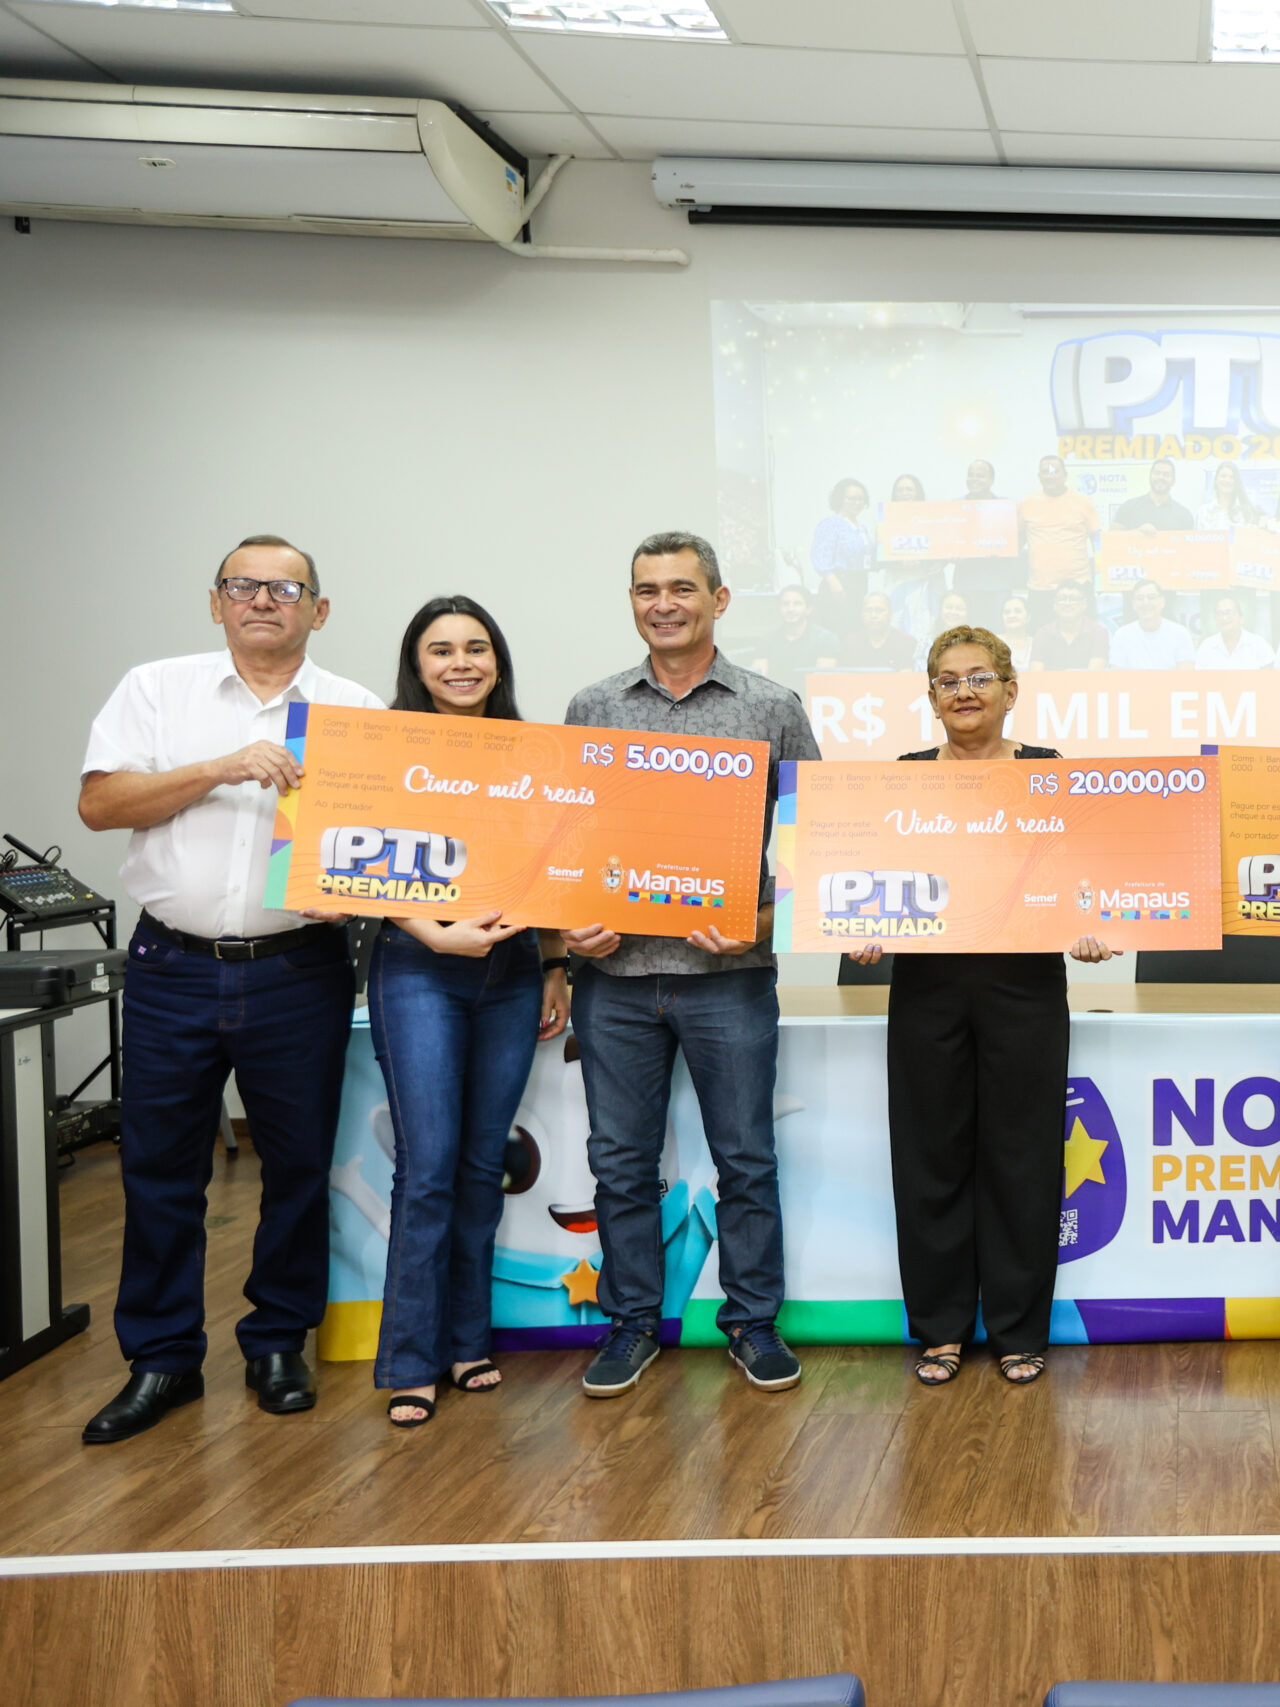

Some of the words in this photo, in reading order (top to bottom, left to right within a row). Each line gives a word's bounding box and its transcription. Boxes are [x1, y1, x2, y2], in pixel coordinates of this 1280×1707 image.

[1058, 434, 1242, 460] PREMIADO
[363, 721, 391, 732] Banco
[401, 725, 436, 736] Agência
[447, 729, 473, 739] Conta
[810, 693, 886, 746] R$
[1037, 692, 1148, 739] MIL
[1171, 691, 1257, 739] EM
[581, 742, 615, 767] R$
[626, 744, 754, 781] 5.000,00
[404, 765, 480, 796] Cinco
[488, 774, 535, 800] mil
[542, 784, 596, 806] reais
[1029, 773, 1059, 795] R$
[1068, 767, 1207, 799] 20.000,00
[332, 801, 373, 812] portador
[1230, 802, 1255, 811] Pague
[1257, 803, 1270, 811] por
[1230, 812, 1259, 822] cheque
[884, 809, 957, 836] Vinte
[966, 809, 1008, 834] mil
[1016, 815, 1065, 834] reais
[1229, 831, 1241, 839] Ao
[1244, 831, 1279, 840] portador
[319, 825, 468, 881] IPTU
[546, 865, 584, 879] Semef
[656, 863, 690, 871] Prefeitura
[316, 874, 462, 903] PREMIADO
[628, 868, 725, 896] Manaus
[818, 869, 949, 915] IPTU
[1024, 893, 1058, 903] Semef
[1100, 889, 1190, 909] Manaus
[818, 916, 947, 938] PREMIADO
